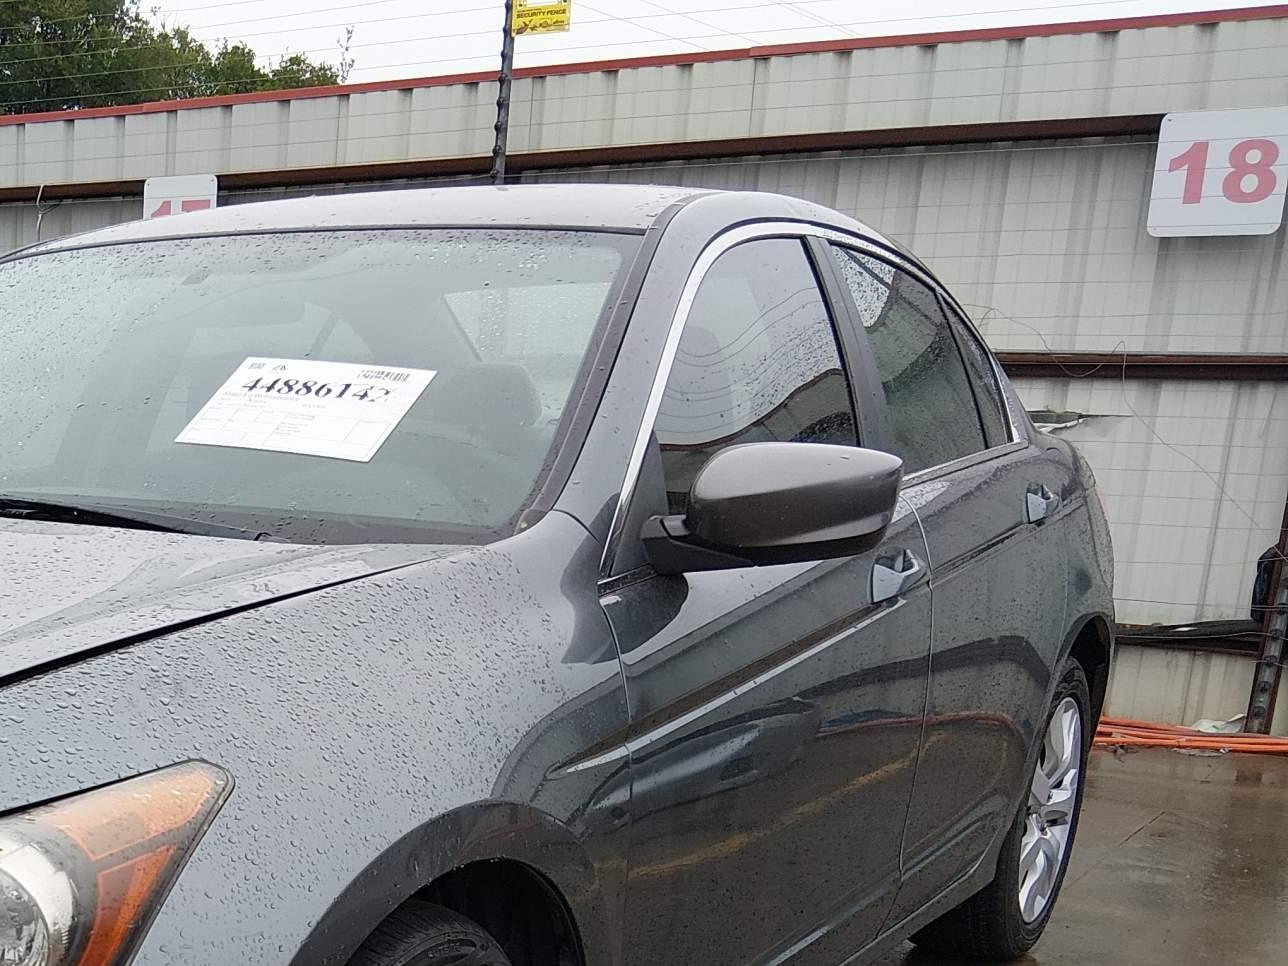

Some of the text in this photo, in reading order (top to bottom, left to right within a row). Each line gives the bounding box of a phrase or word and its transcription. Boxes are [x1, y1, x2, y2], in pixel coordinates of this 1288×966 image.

[516, 11, 546, 19] SECURITY
[547, 8, 567, 16] FENCE
[1168, 138, 1280, 205] 18
